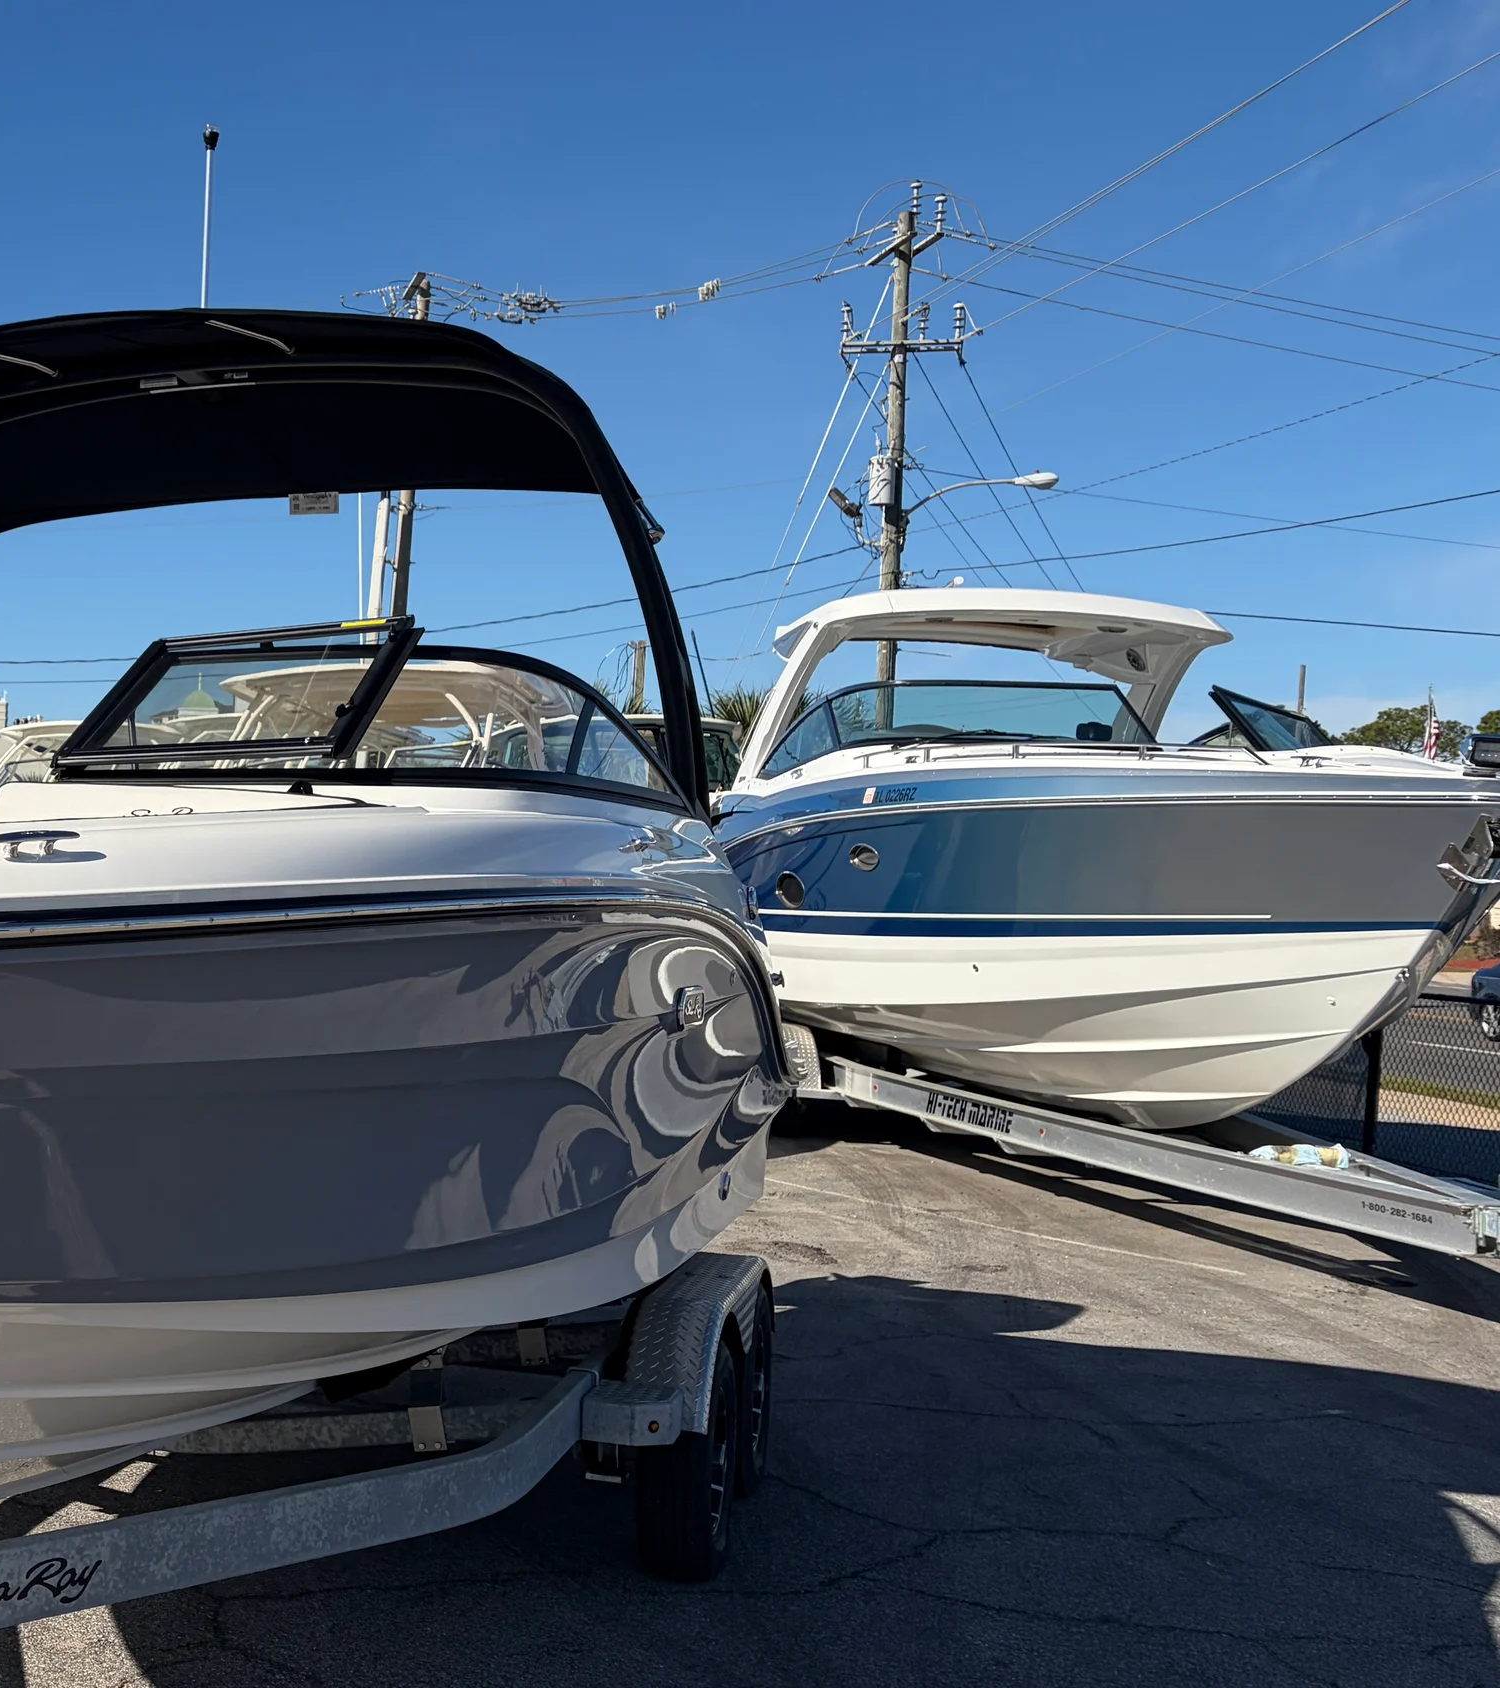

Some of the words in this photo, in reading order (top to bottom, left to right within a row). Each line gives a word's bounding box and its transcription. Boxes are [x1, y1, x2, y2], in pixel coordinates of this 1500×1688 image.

[885, 787, 917, 803] 0226RZ
[926, 1092, 967, 1121] HI-TECH
[1361, 1201, 1433, 1224] 1-800-282-1684
[17, 1557, 102, 1604] Ray
